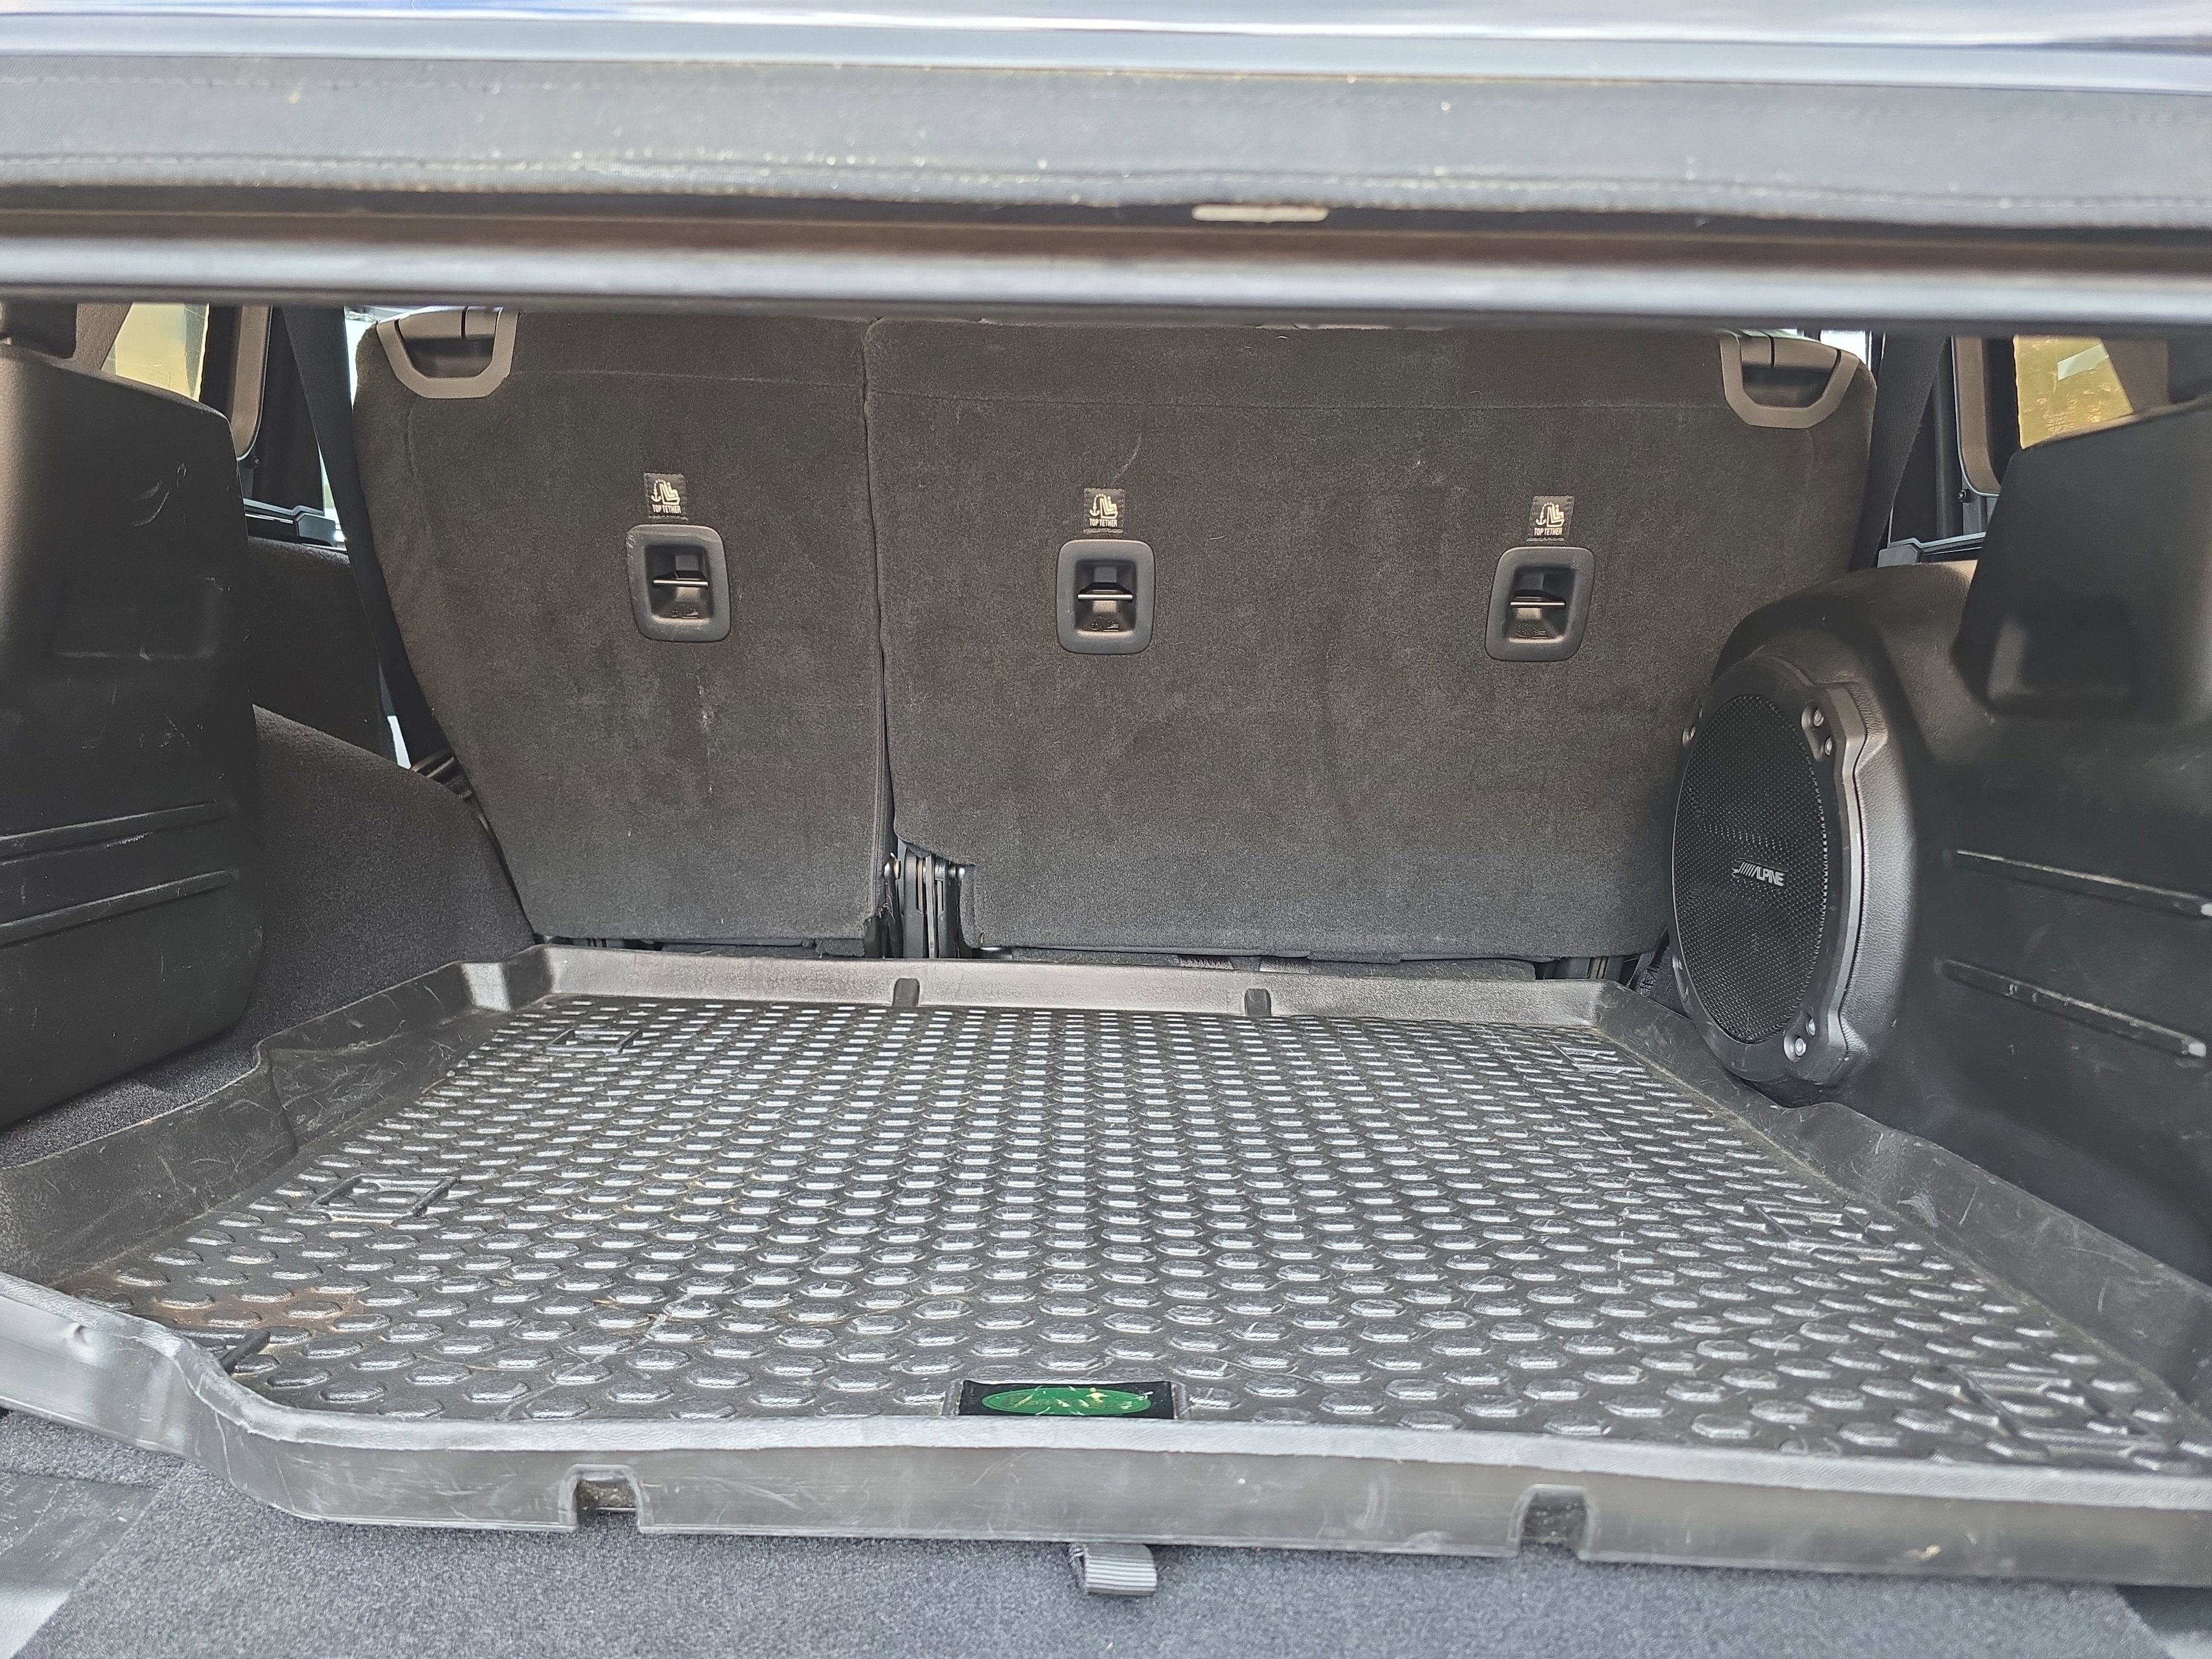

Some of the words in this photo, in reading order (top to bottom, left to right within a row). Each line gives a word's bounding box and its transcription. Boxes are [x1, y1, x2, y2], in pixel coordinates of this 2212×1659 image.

[652, 504, 662, 513] TOP
[663, 505, 681, 514] TETHER
[1089, 518, 1099, 526] TOP
[1099, 519, 1117, 527] TETHER
[1534, 528, 1544, 536] TOP
[1544, 528, 1562, 536] TETHER
[1747, 863, 1785, 886] ALPINE
